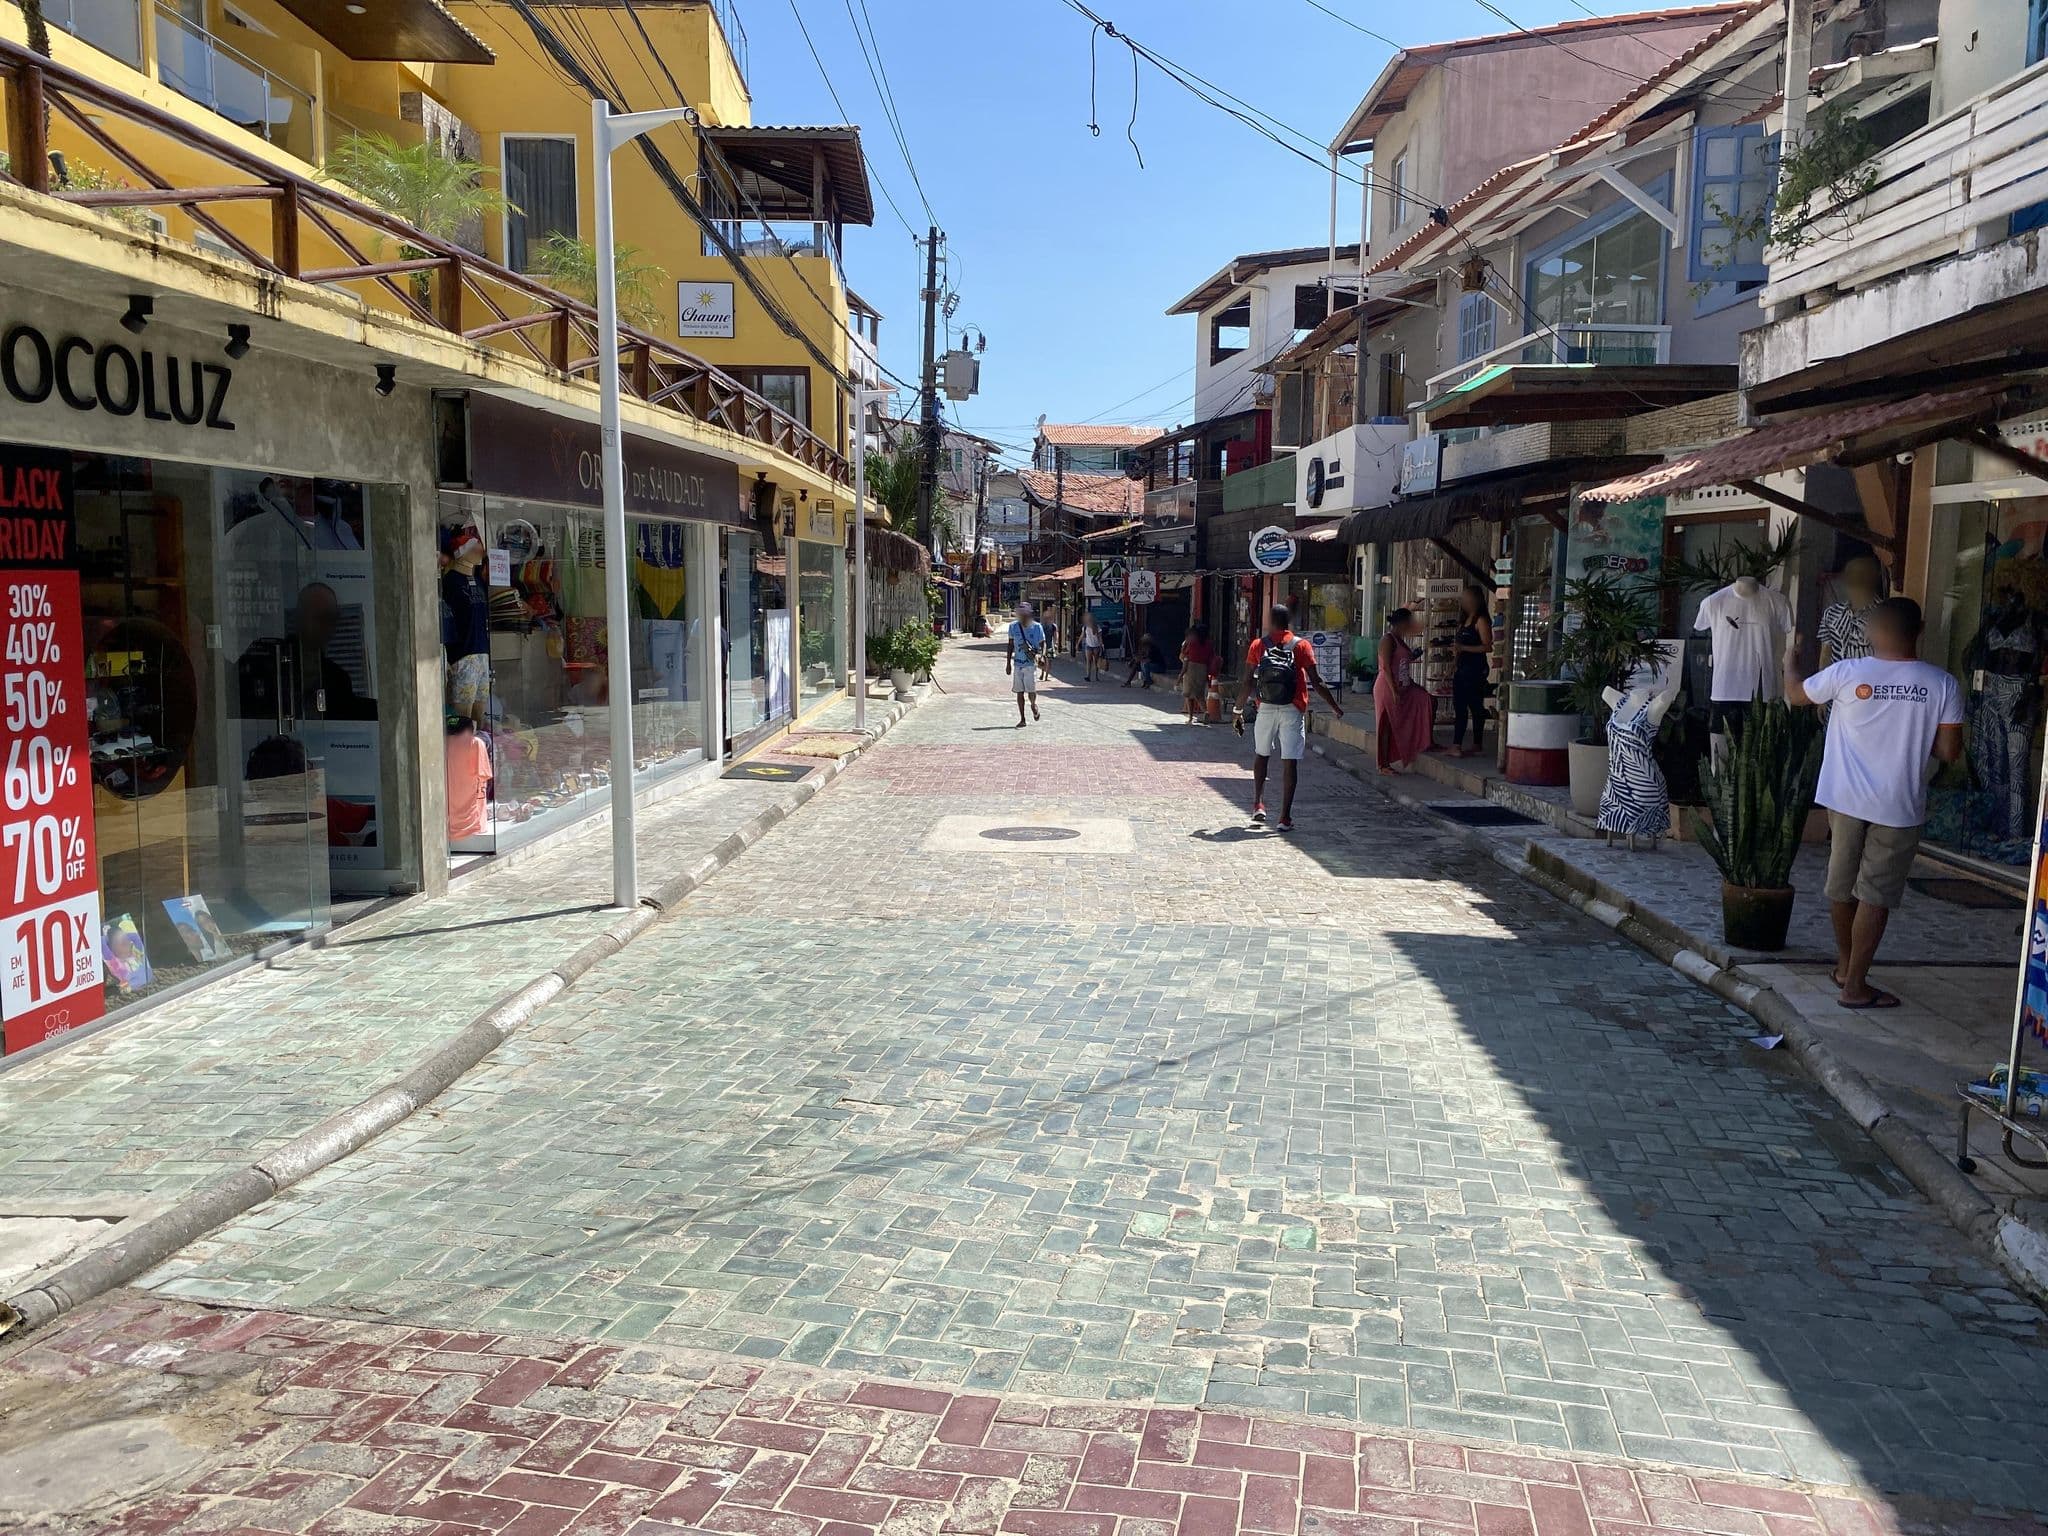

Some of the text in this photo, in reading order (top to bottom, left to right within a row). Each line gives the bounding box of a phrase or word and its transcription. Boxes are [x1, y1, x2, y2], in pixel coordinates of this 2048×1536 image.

[1, 326, 235, 430] OCOLUZ
[0, 466, 63, 512] LACK
[650, 467, 705, 507] SAUDADE
[0, 519, 67, 560] RIDAY
[8, 584, 52, 618] 30%
[1431, 584, 1458, 593] melissa
[6, 621, 60, 665] 40%
[5, 670, 66, 732] 50%
[1874, 684, 1928, 697] ESTEVÃO
[1891, 694, 1927, 703] MERCADO
[4, 736, 76, 811] 60%
[3, 815, 85, 905] 70%
[66, 859, 85, 881] OFF
[10, 955, 22, 970] EM
[75, 955, 93, 972] SEM
[75, 971, 95, 988] JUROS
[12, 970, 26, 990] ATÉ
